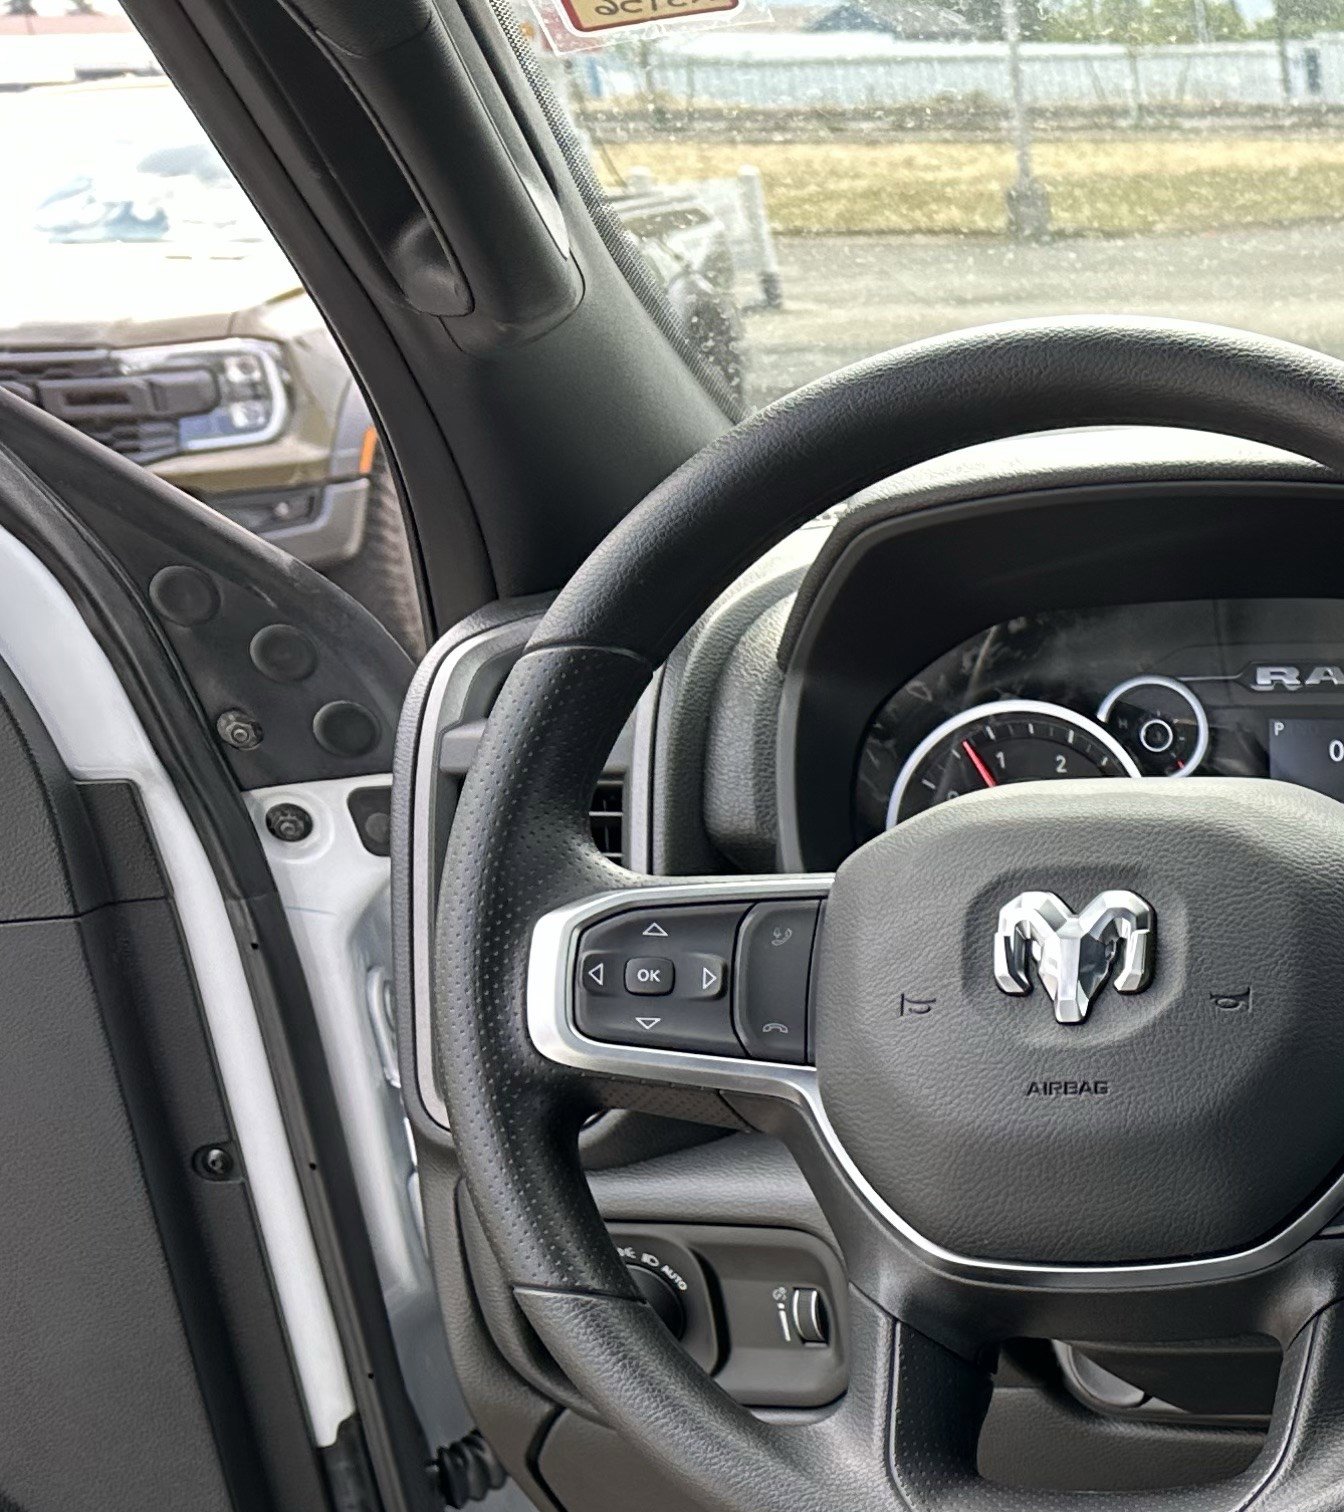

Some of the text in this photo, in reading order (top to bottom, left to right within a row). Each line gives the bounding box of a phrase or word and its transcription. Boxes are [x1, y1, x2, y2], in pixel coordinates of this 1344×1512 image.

[1273, 721, 1285, 736] P
[1328, 739, 1344, 762] 0
[996, 751, 1006, 769] 1
[1055, 755, 1067, 773] 2
[637, 968, 660, 982] OK
[1026, 1080, 1110, 1097] AIRBAG
[660, 1263, 689, 1292] AUTO
